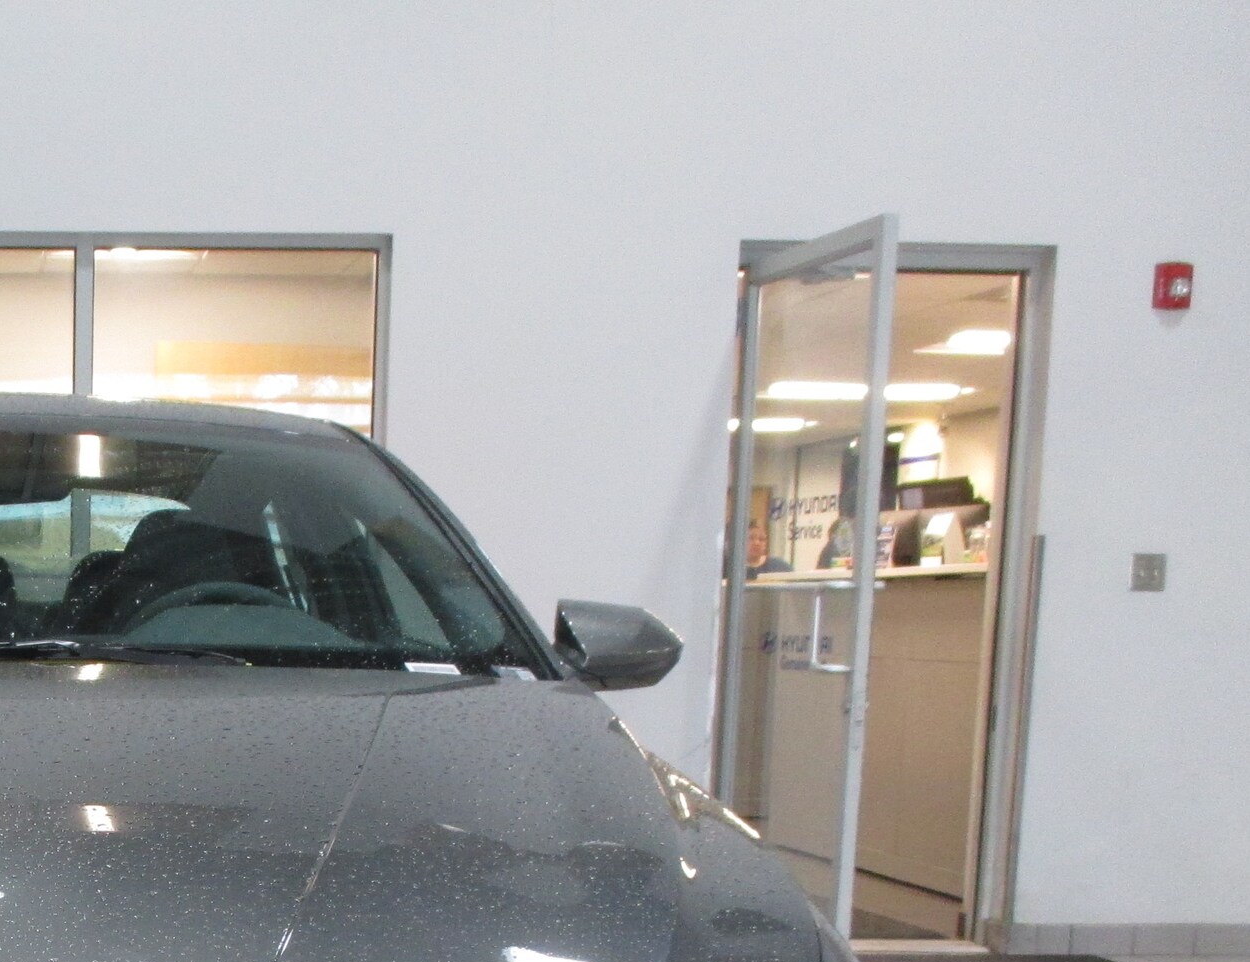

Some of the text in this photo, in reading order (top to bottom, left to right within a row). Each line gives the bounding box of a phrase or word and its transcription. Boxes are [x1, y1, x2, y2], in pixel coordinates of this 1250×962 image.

[788, 494, 838, 515] HYUNDA
[788, 522, 822, 540] Service
[781, 635, 833, 654] HYUNAI
